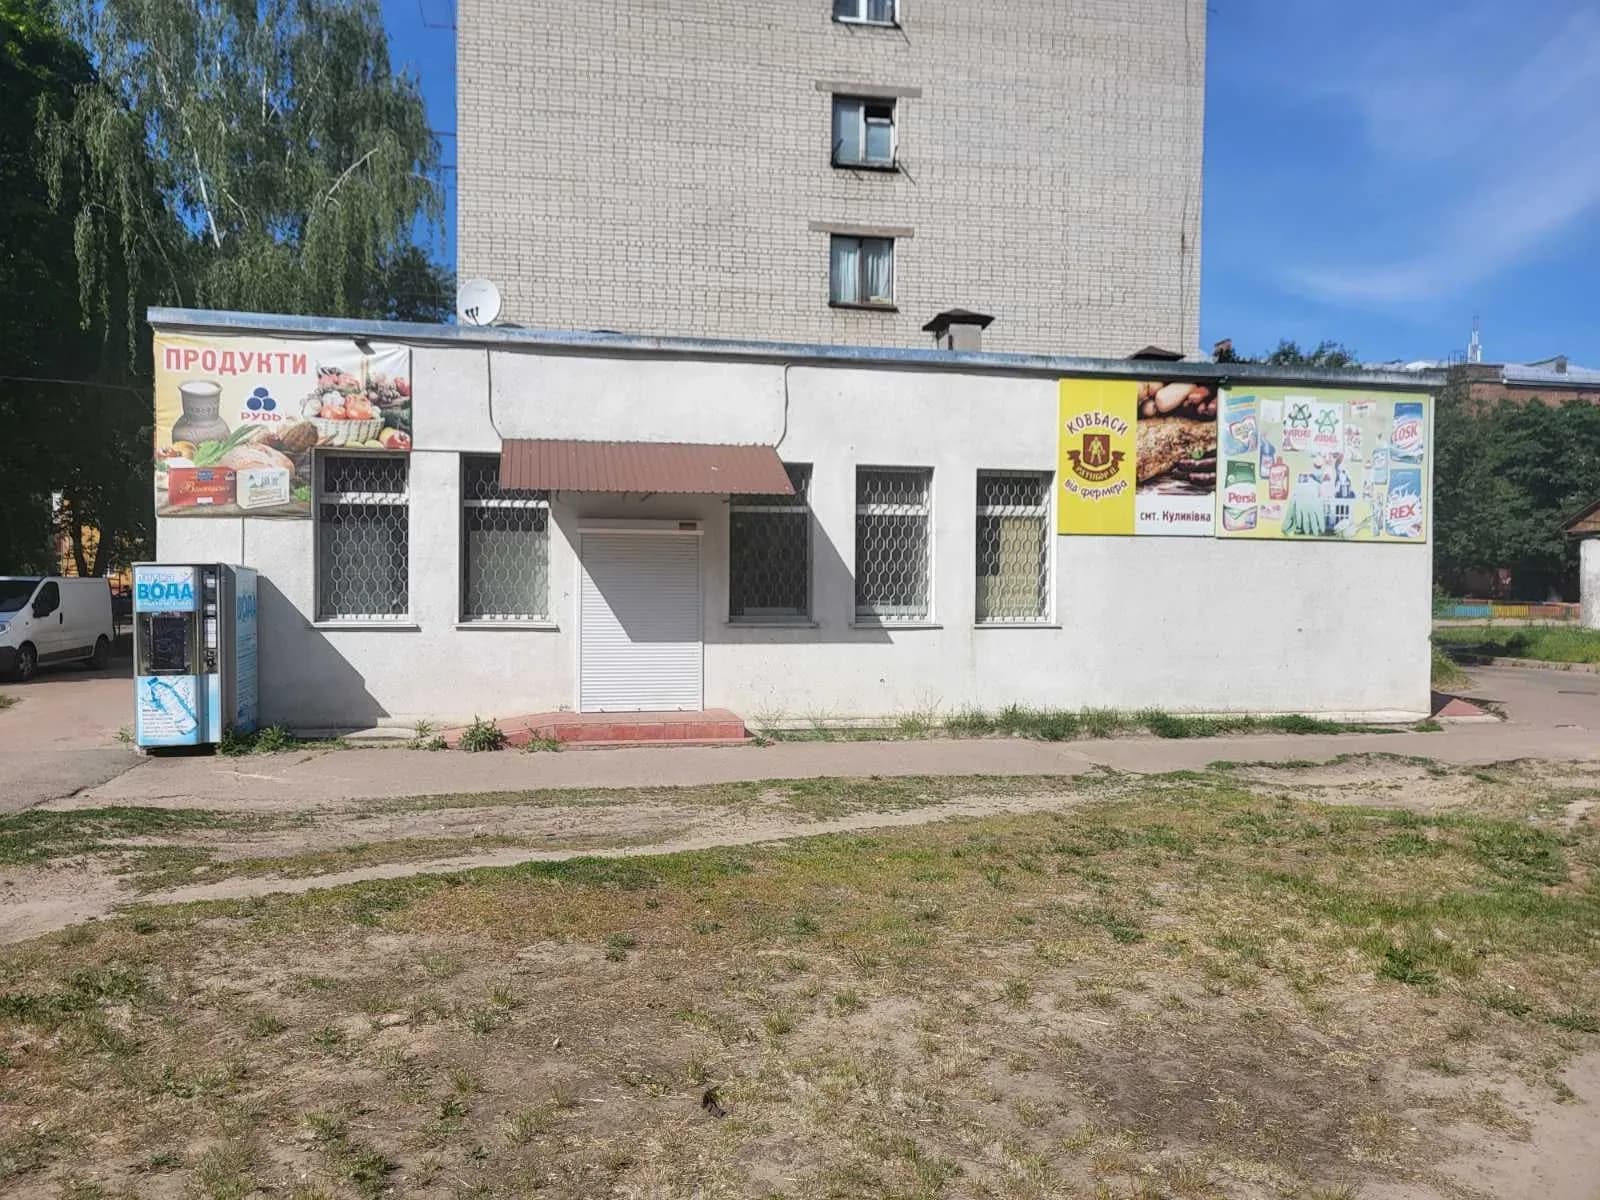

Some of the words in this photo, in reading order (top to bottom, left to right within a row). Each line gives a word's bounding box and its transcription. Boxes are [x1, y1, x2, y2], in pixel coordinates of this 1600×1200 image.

[165, 348, 307, 375] ПРОДУКТИ
[1066, 413, 1129, 435] КОВБАСИ
[1394, 424, 1418, 441] LOSK
[1080, 480, 1128, 500] фермера
[1140, 512, 1159, 521] смт.
[1162, 510, 1211, 523] Куликівка
[1390, 504, 1416, 519] REX
[137, 582, 192, 600] ВОДА
